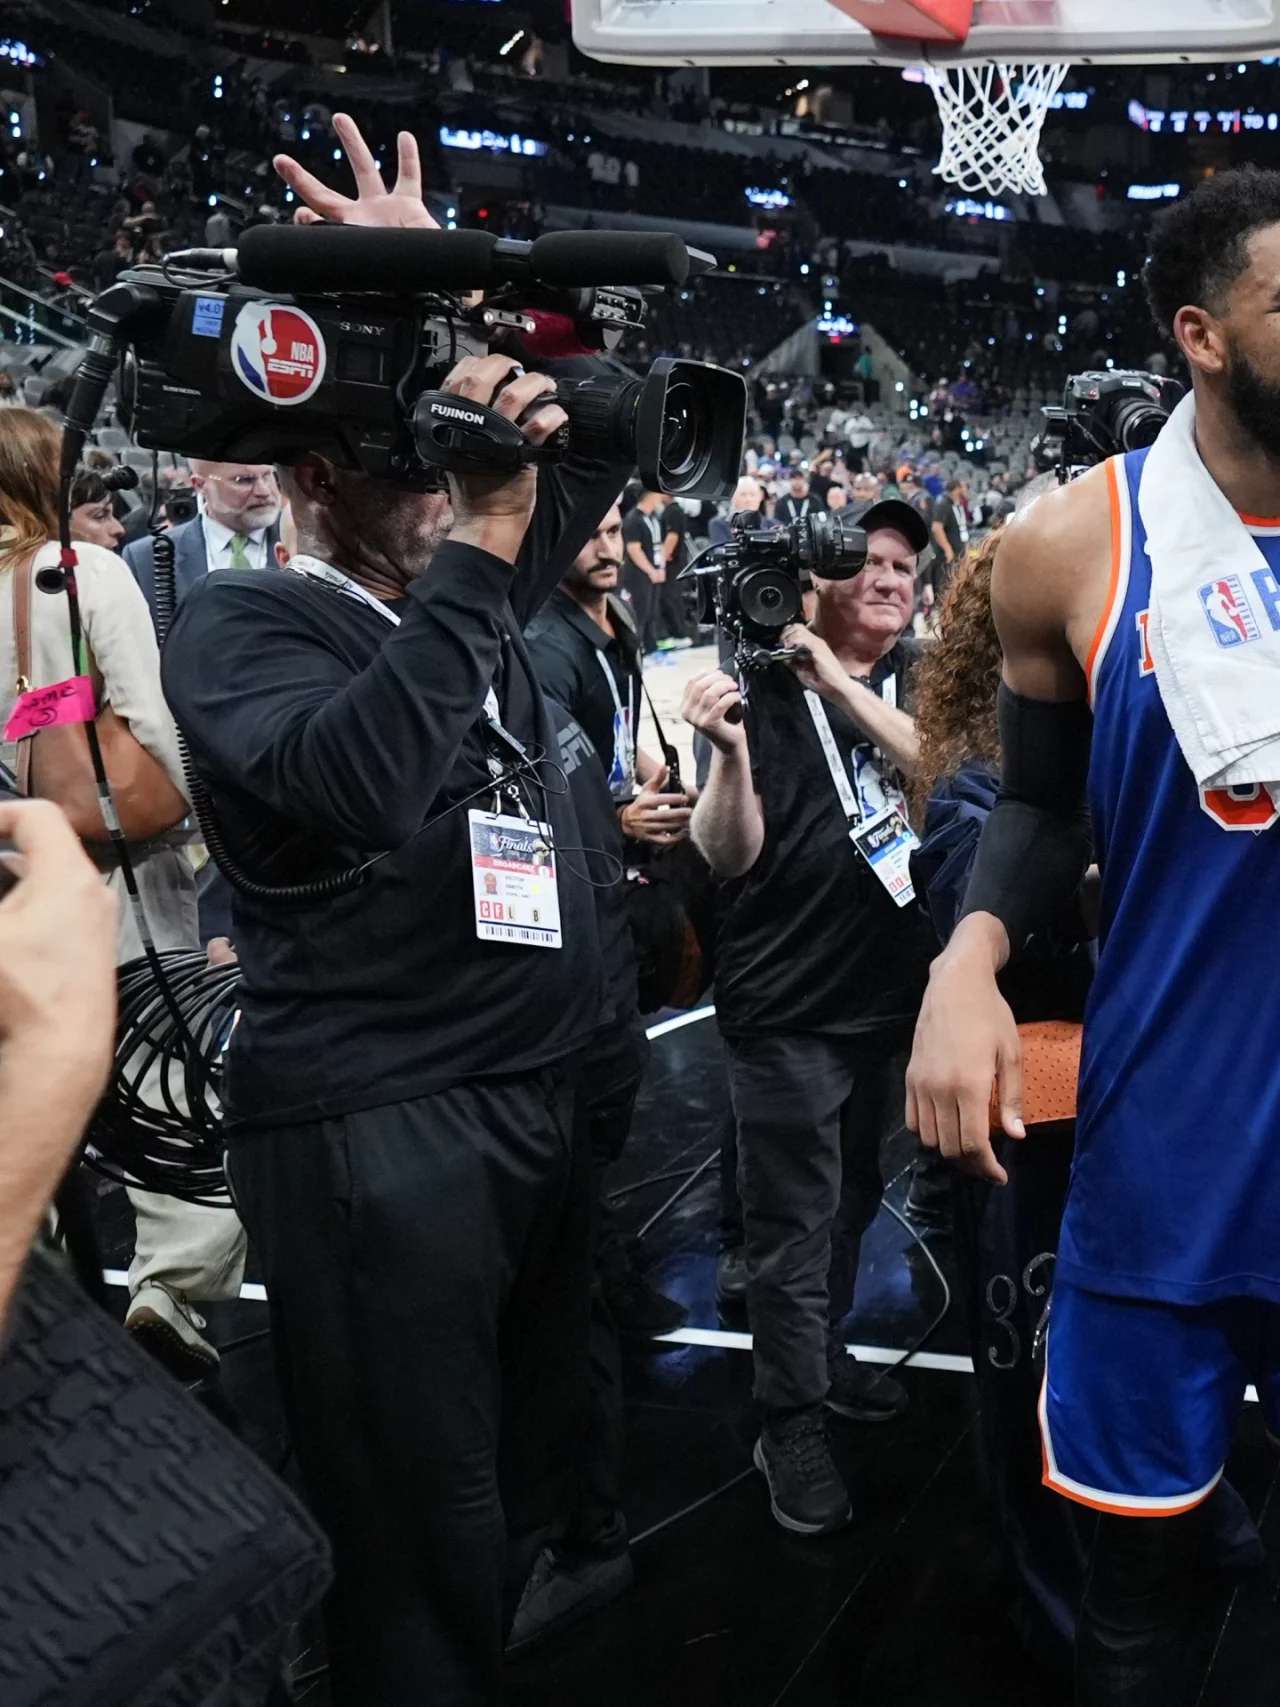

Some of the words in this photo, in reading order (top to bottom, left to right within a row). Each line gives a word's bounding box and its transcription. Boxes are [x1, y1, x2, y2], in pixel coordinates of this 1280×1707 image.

[339, 321, 385, 336] SONY
[290, 341, 314, 363] NBA
[267, 357, 314, 379] ESPN
[430, 403, 485, 426] FUJINON
[497, 834, 533, 854] Finals
